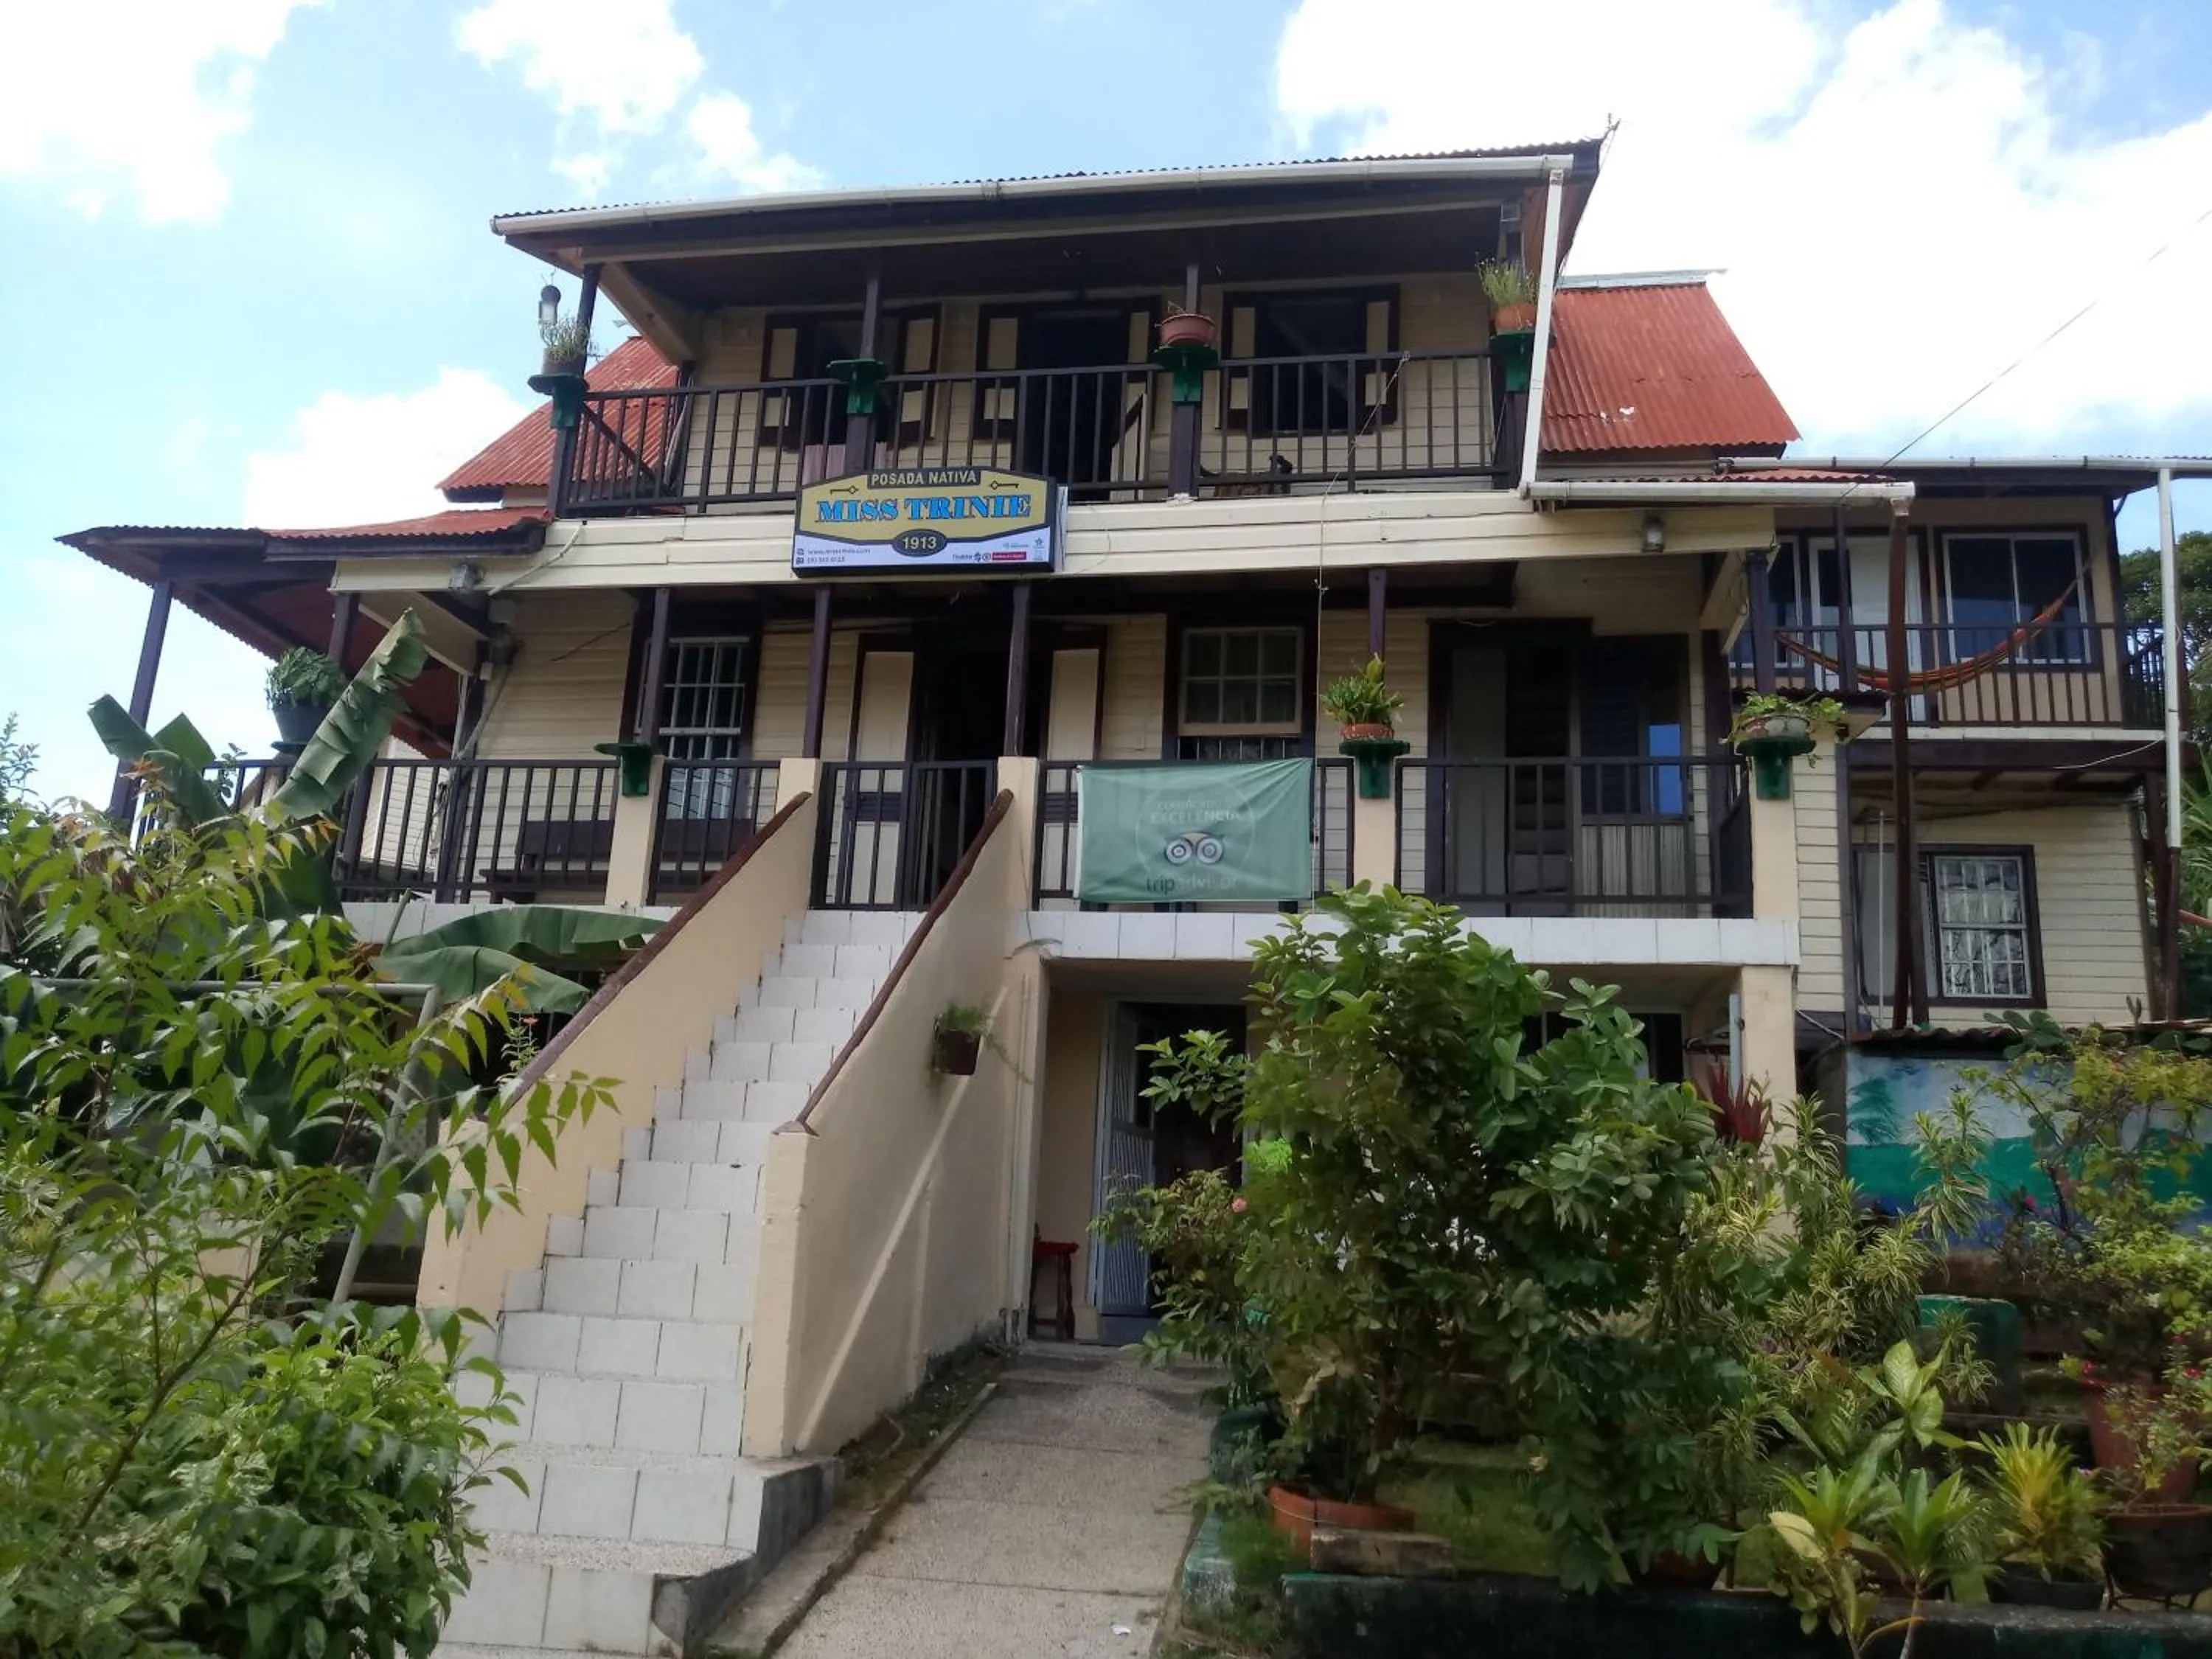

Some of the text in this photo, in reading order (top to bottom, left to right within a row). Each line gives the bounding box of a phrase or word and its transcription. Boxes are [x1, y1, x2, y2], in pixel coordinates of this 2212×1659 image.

[871, 470, 977, 485] POSADA NATIVA
[815, 495, 1032, 522] MISS TRINIE
[902, 537, 937, 549] 1913
